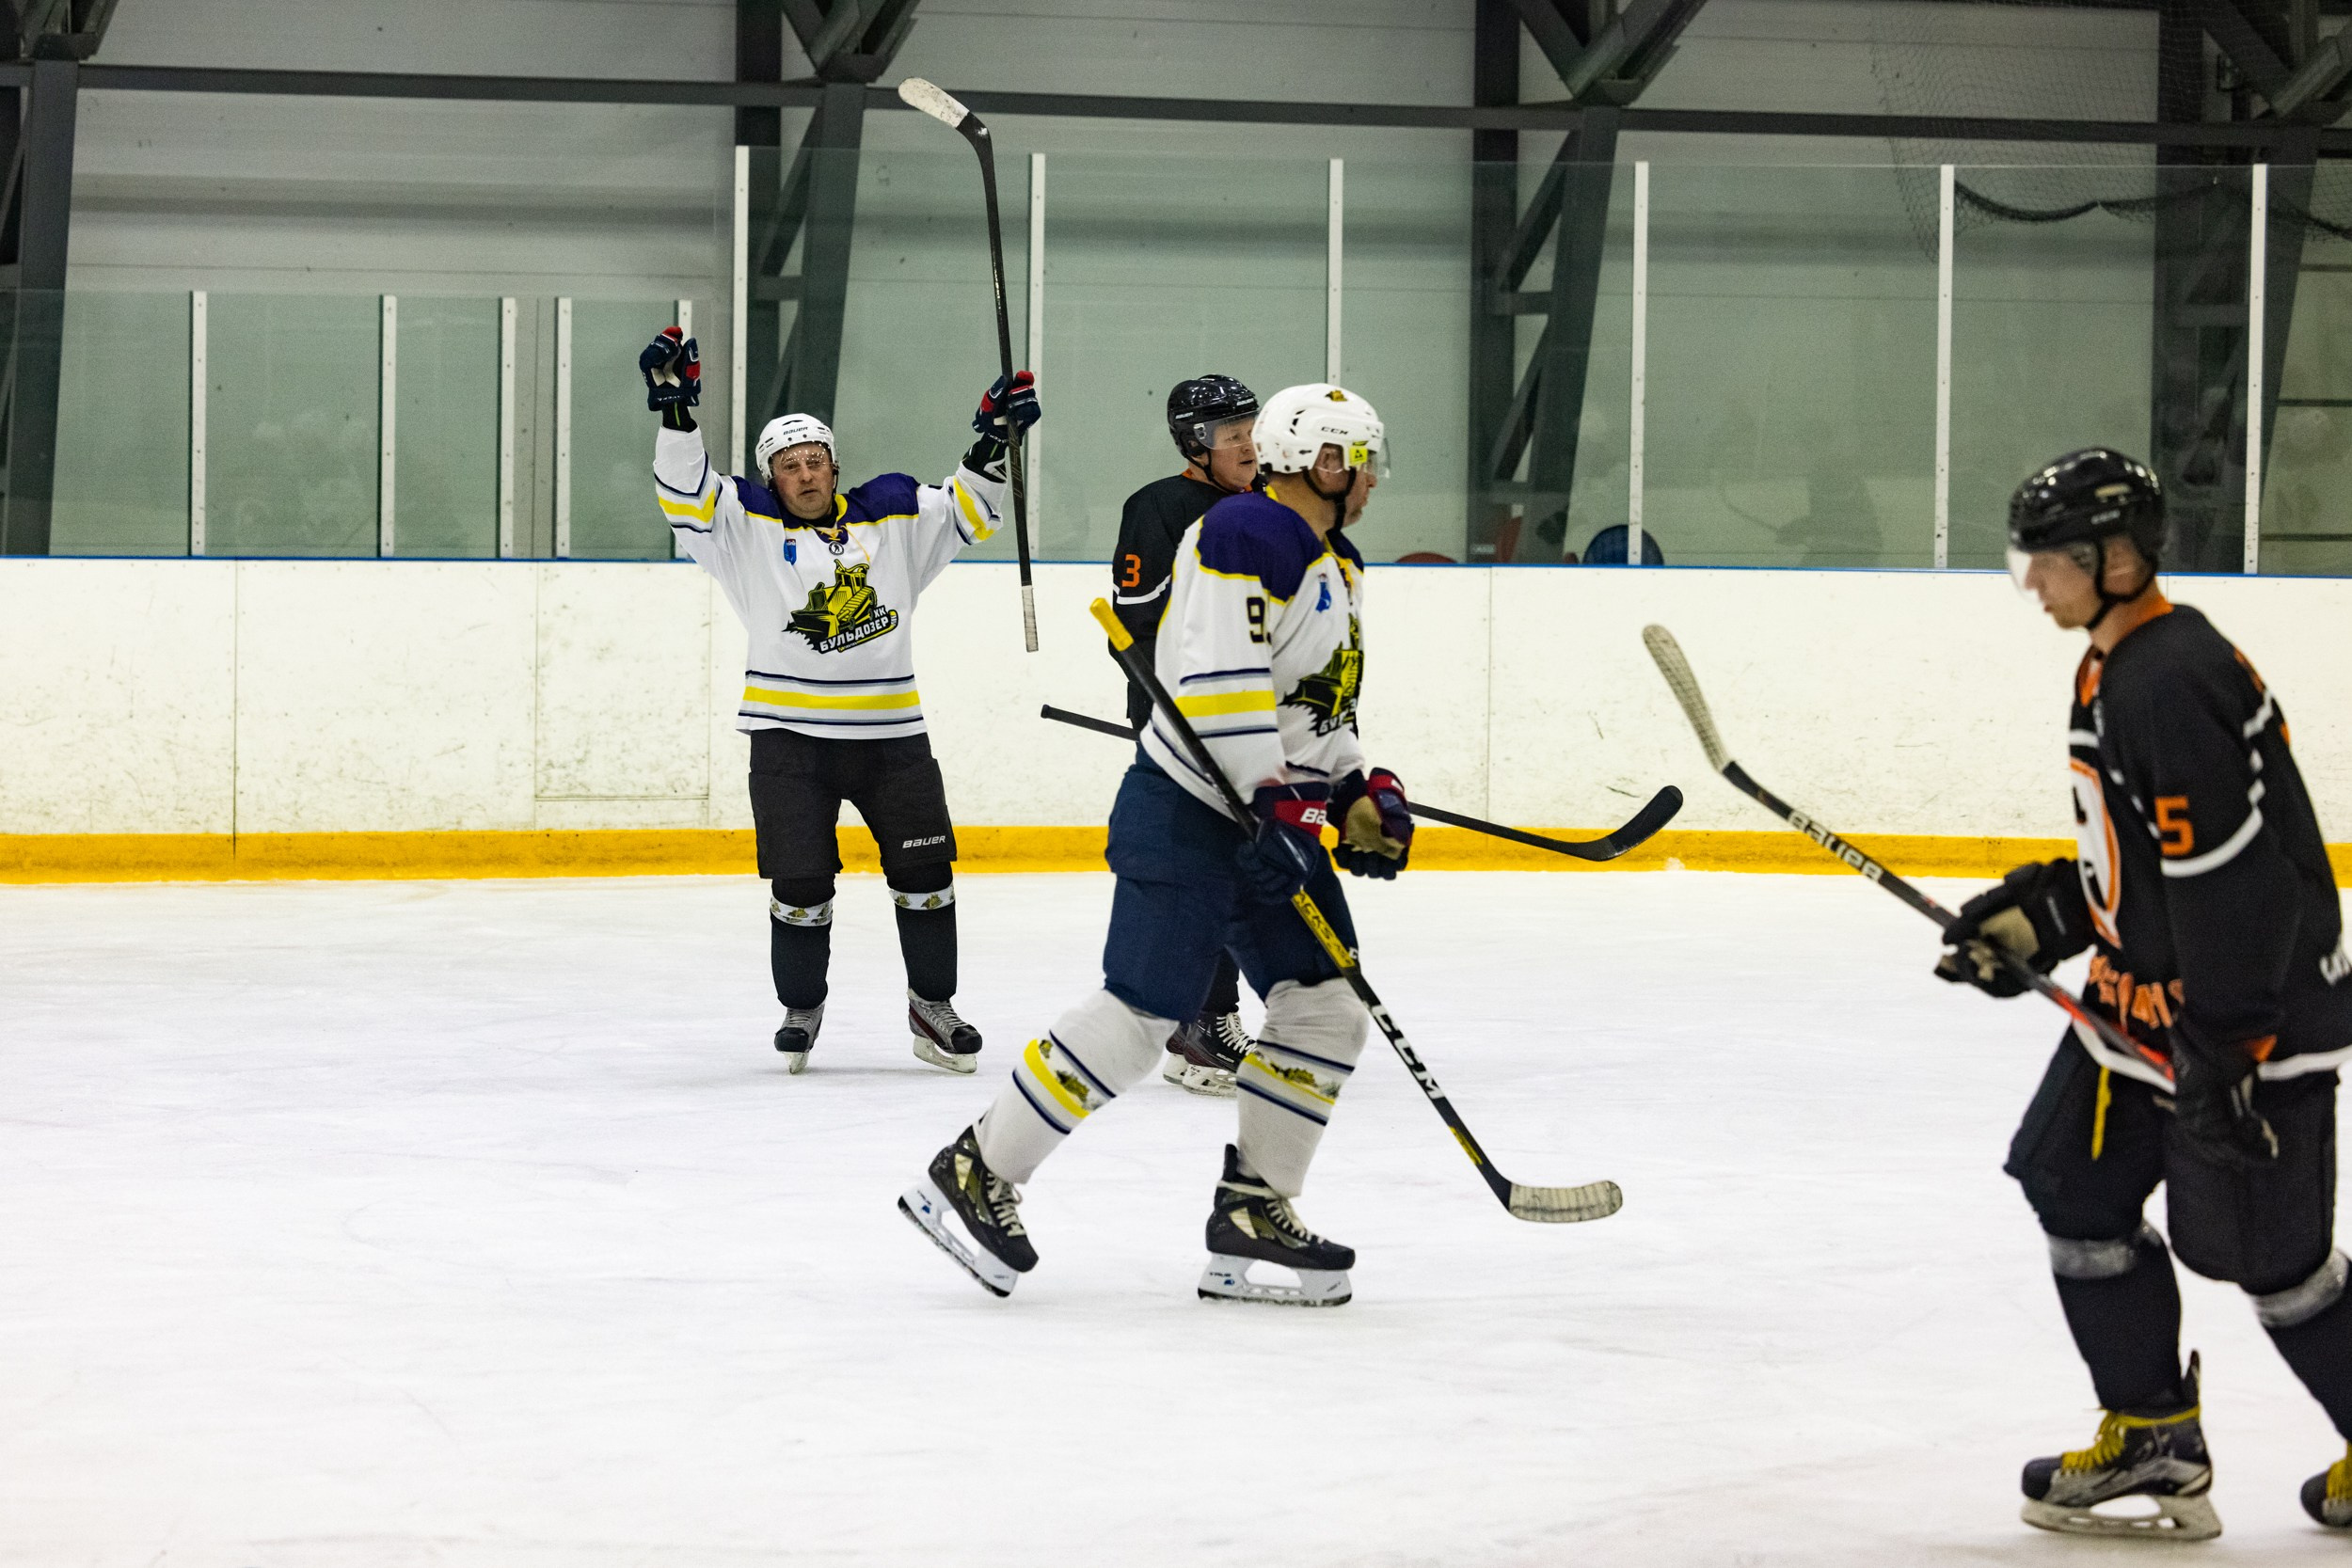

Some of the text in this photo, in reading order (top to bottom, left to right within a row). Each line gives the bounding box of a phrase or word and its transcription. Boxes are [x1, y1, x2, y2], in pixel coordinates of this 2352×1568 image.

[1321, 426, 1349, 436] CCM
[1121, 553, 1141, 588] 3
[873, 607, 886, 619] ХК
[819, 616, 890, 652] БУЛЬДОЗЕР
[902, 835, 946, 848] BAUER
[2154, 796, 2195, 856] 5
[1372, 1004, 1445, 1100] CCM
